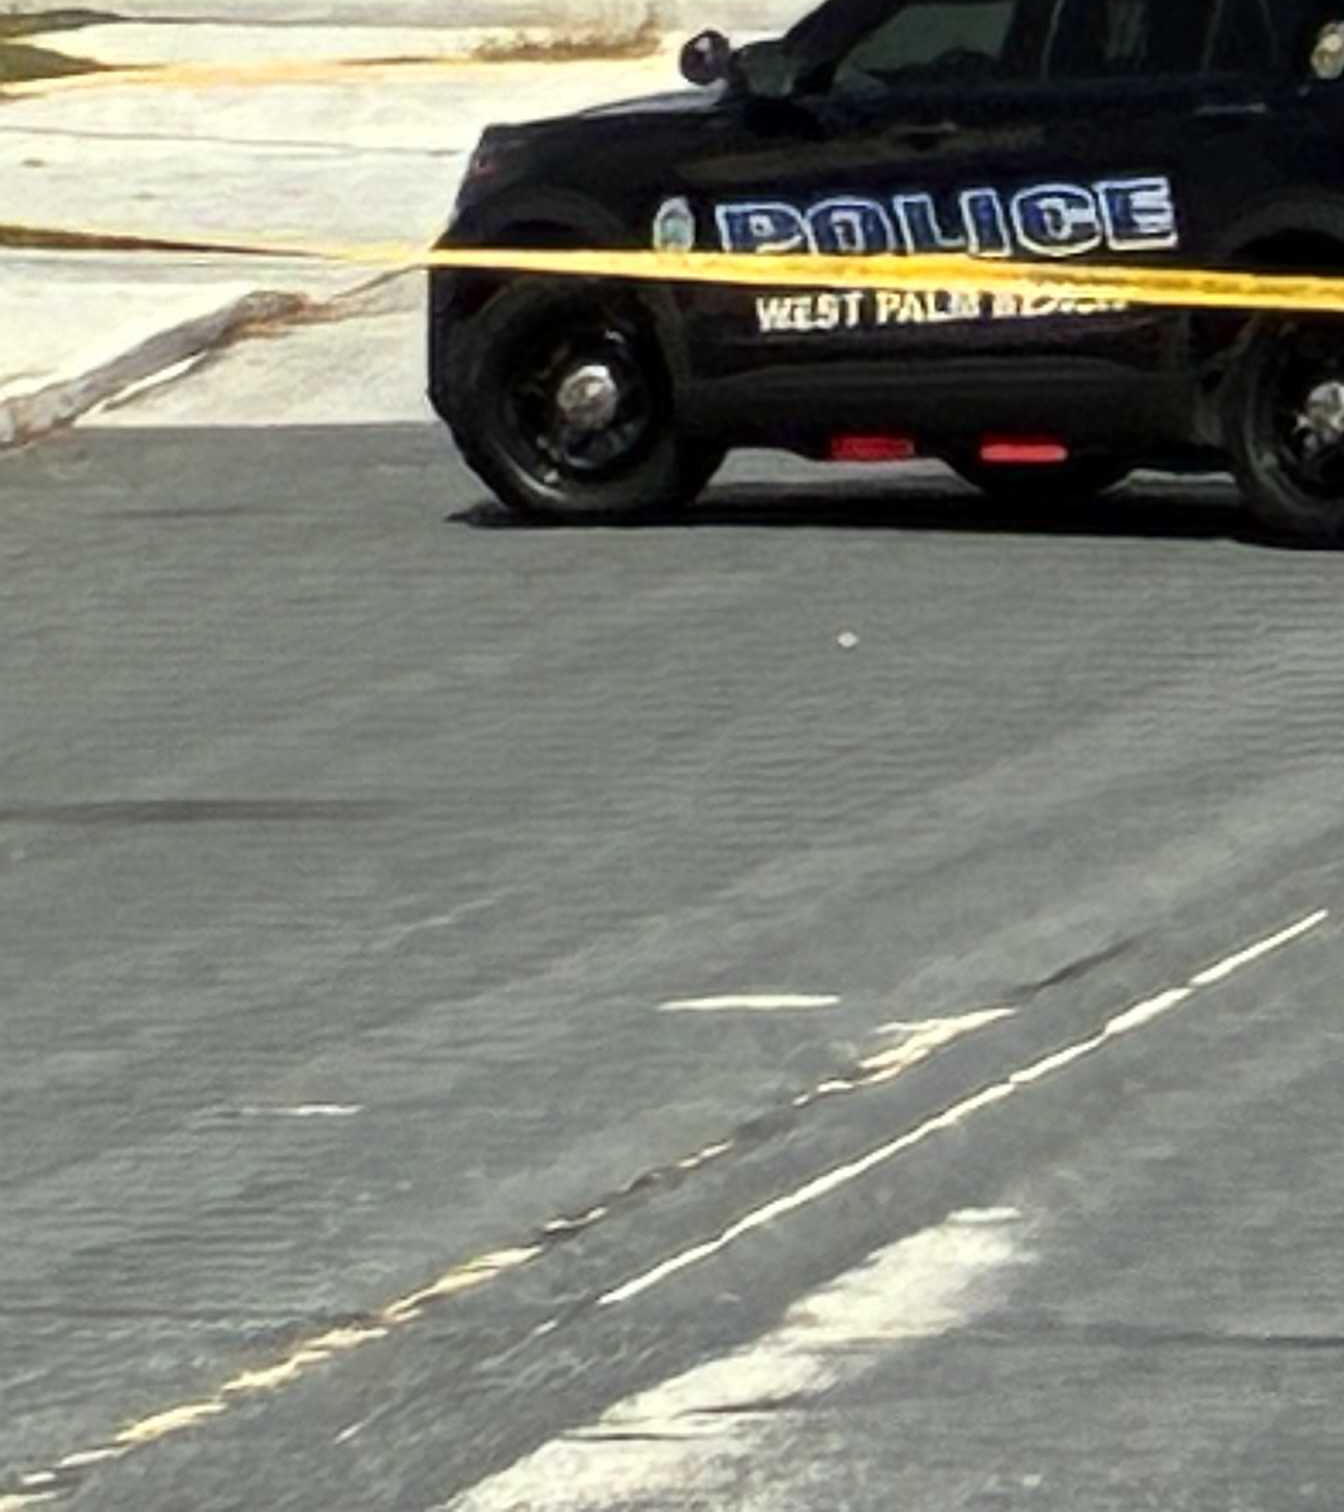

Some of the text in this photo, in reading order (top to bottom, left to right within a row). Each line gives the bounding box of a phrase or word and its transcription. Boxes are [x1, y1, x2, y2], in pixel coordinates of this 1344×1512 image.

[714, 177, 1179, 257] POLICE
[755, 291, 864, 332] WEST
[875, 286, 981, 324] PALM
